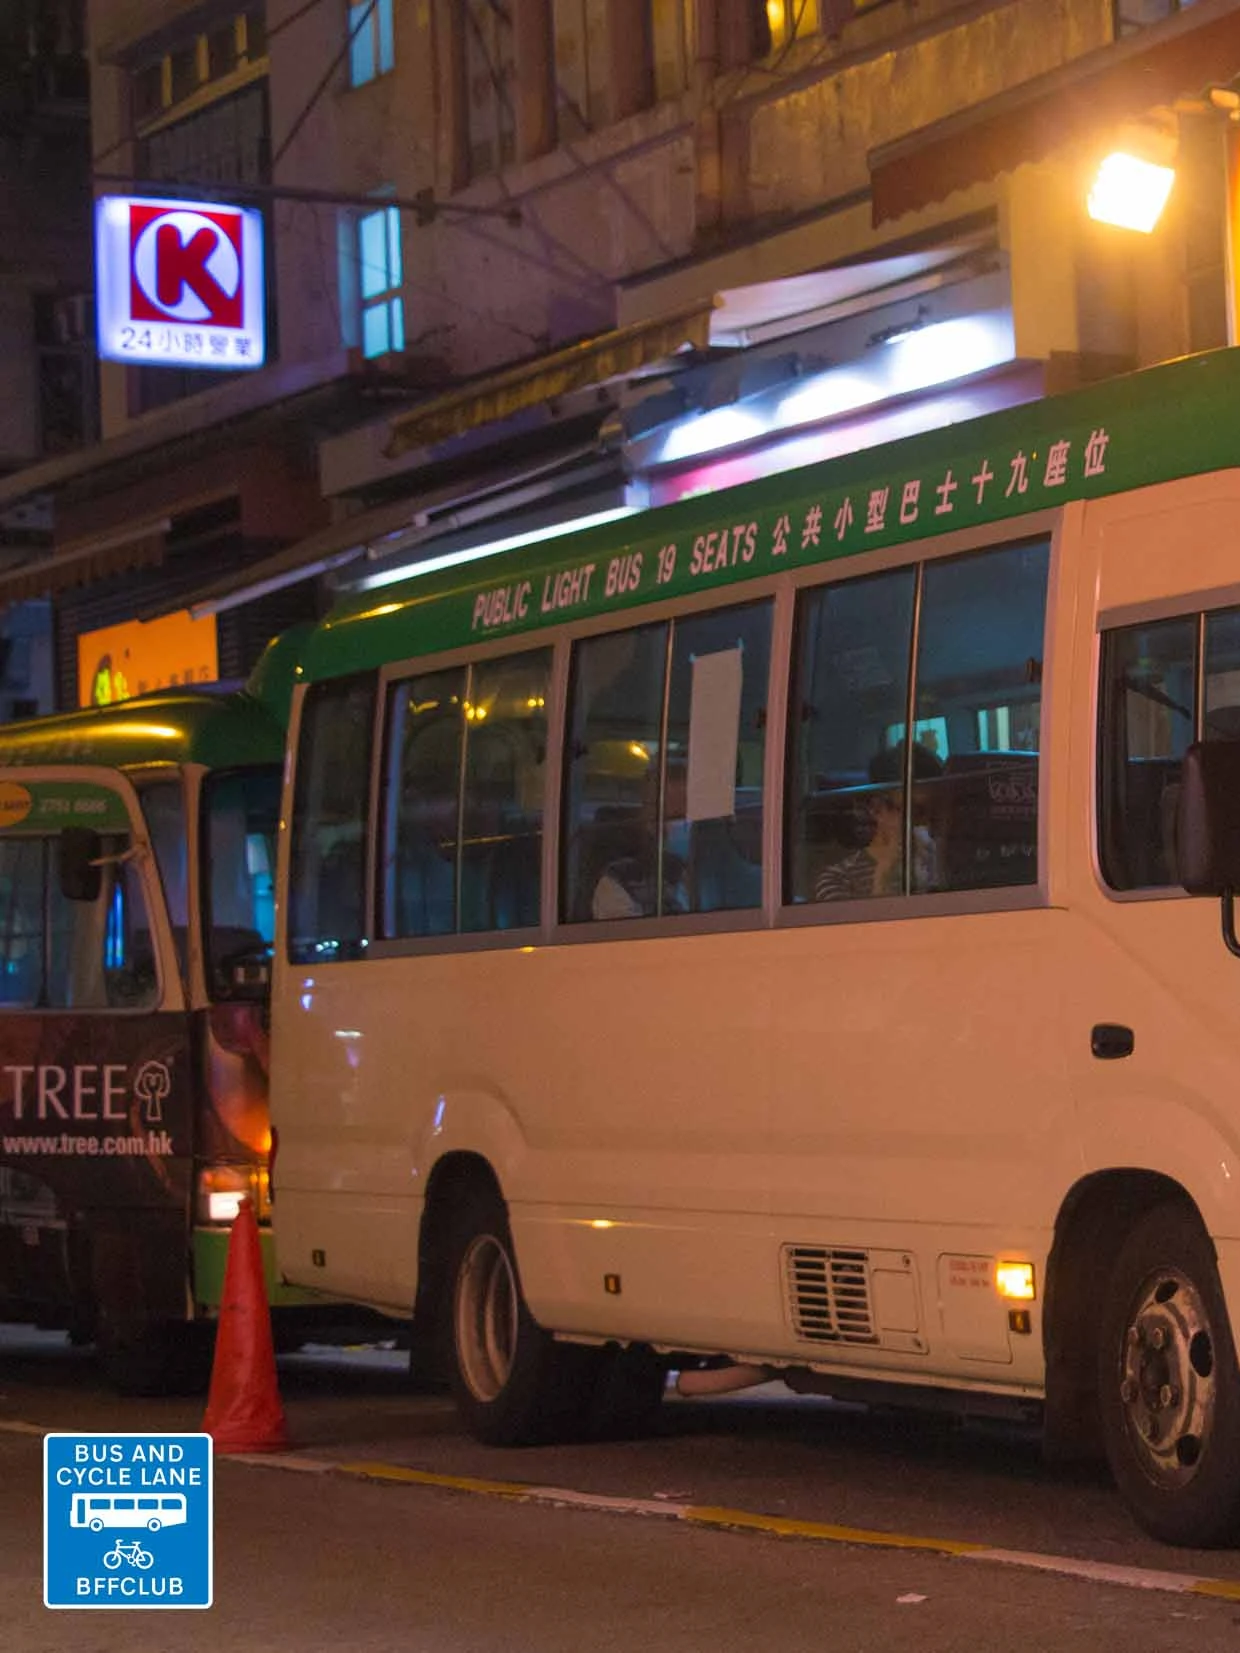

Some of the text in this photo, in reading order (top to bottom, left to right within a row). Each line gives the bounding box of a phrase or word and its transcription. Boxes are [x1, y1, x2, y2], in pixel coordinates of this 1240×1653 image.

[154, 222, 238, 316] K
[771, 427, 1109, 555] 公共小型巴士十九座位
[471, 521, 758, 630] PUBLIC LIGHT BUS 19 SEATS
[3, 1064, 128, 1119] TREE
[3, 1131, 173, 1154] www.tree.com.hk
